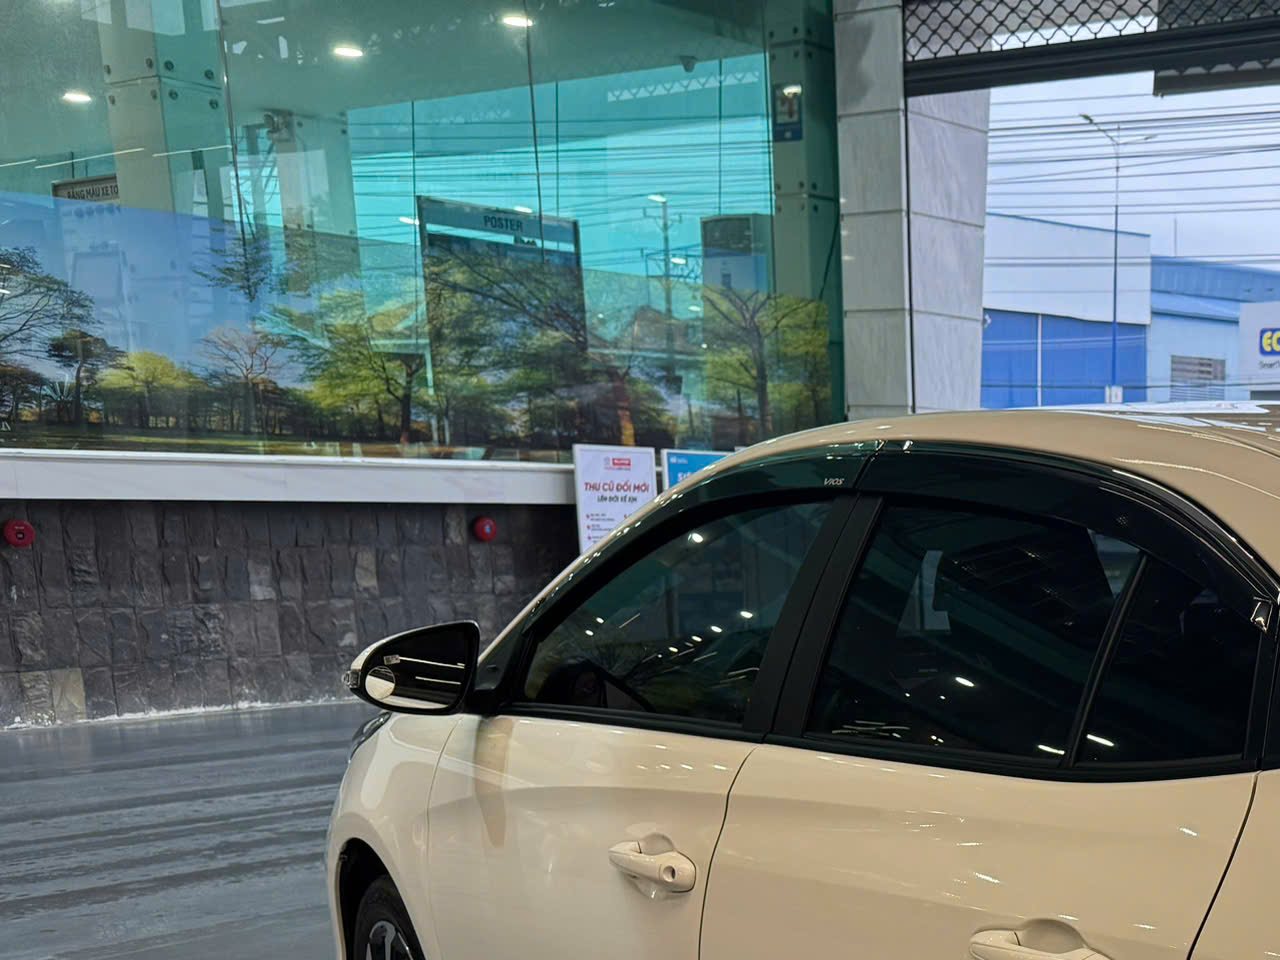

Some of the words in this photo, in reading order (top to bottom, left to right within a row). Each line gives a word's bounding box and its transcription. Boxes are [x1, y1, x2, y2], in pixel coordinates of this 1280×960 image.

[483, 215, 524, 232] POSTER
[584, 482, 601, 491] THU
[824, 478, 845, 486] VIOS
